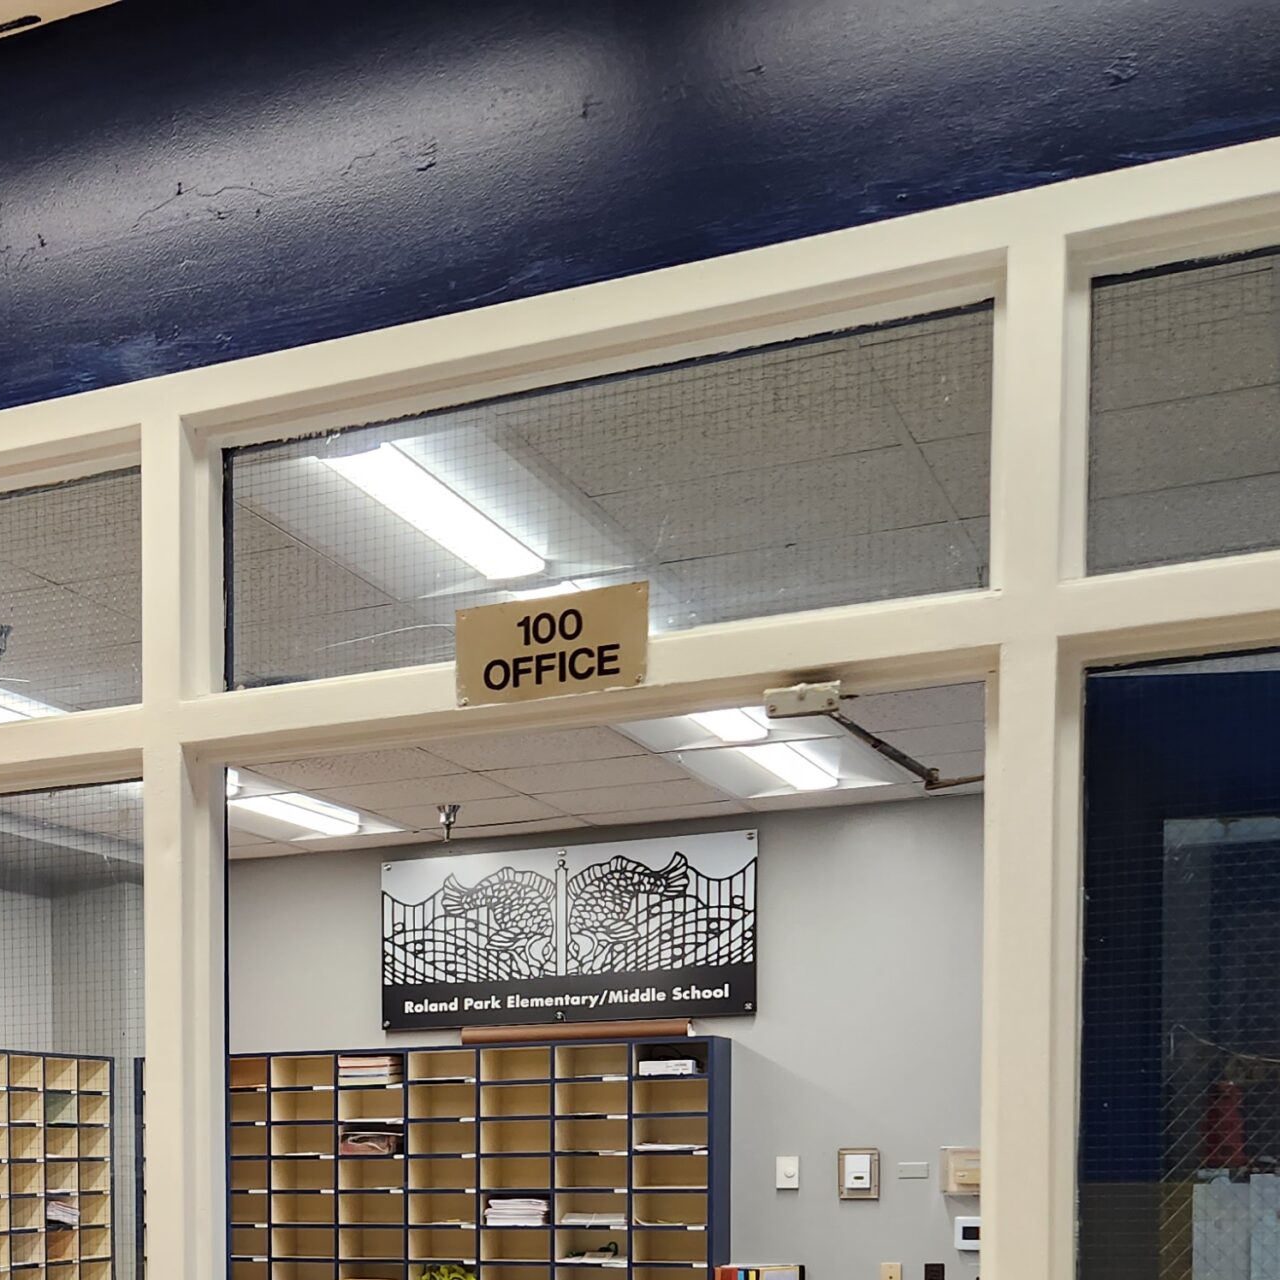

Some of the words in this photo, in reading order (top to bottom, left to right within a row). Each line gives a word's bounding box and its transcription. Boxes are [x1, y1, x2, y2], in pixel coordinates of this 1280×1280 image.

[517, 608, 583, 646] 100
[483, 643, 621, 691] OFFICE
[404, 997, 459, 1014] Roland
[463, 995, 502, 1011] Park
[506, 987, 667, 1009] Elementary/Middle
[671, 983, 730, 1001] School
